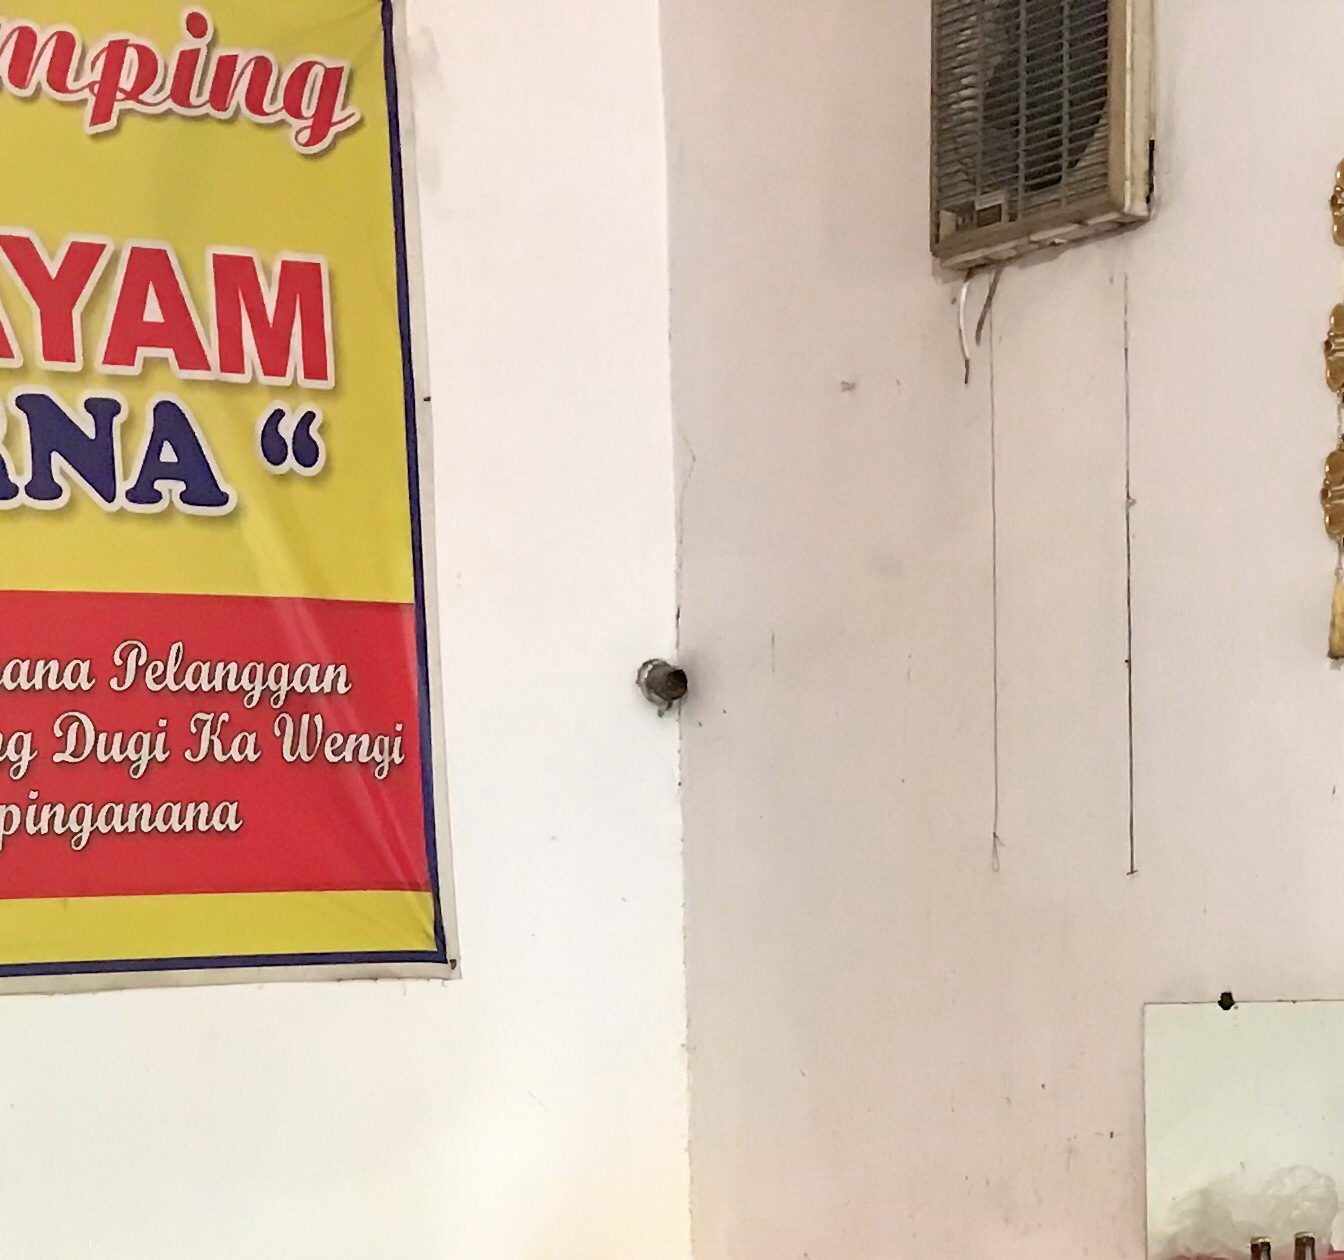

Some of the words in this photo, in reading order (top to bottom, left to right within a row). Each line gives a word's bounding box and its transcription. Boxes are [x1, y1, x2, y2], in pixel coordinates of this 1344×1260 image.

[108, 639, 352, 710] Pelanggan
[51, 714, 171, 780] Dugi
[183, 713, 262, 764] Ka
[273, 716, 406, 781] Wengi
